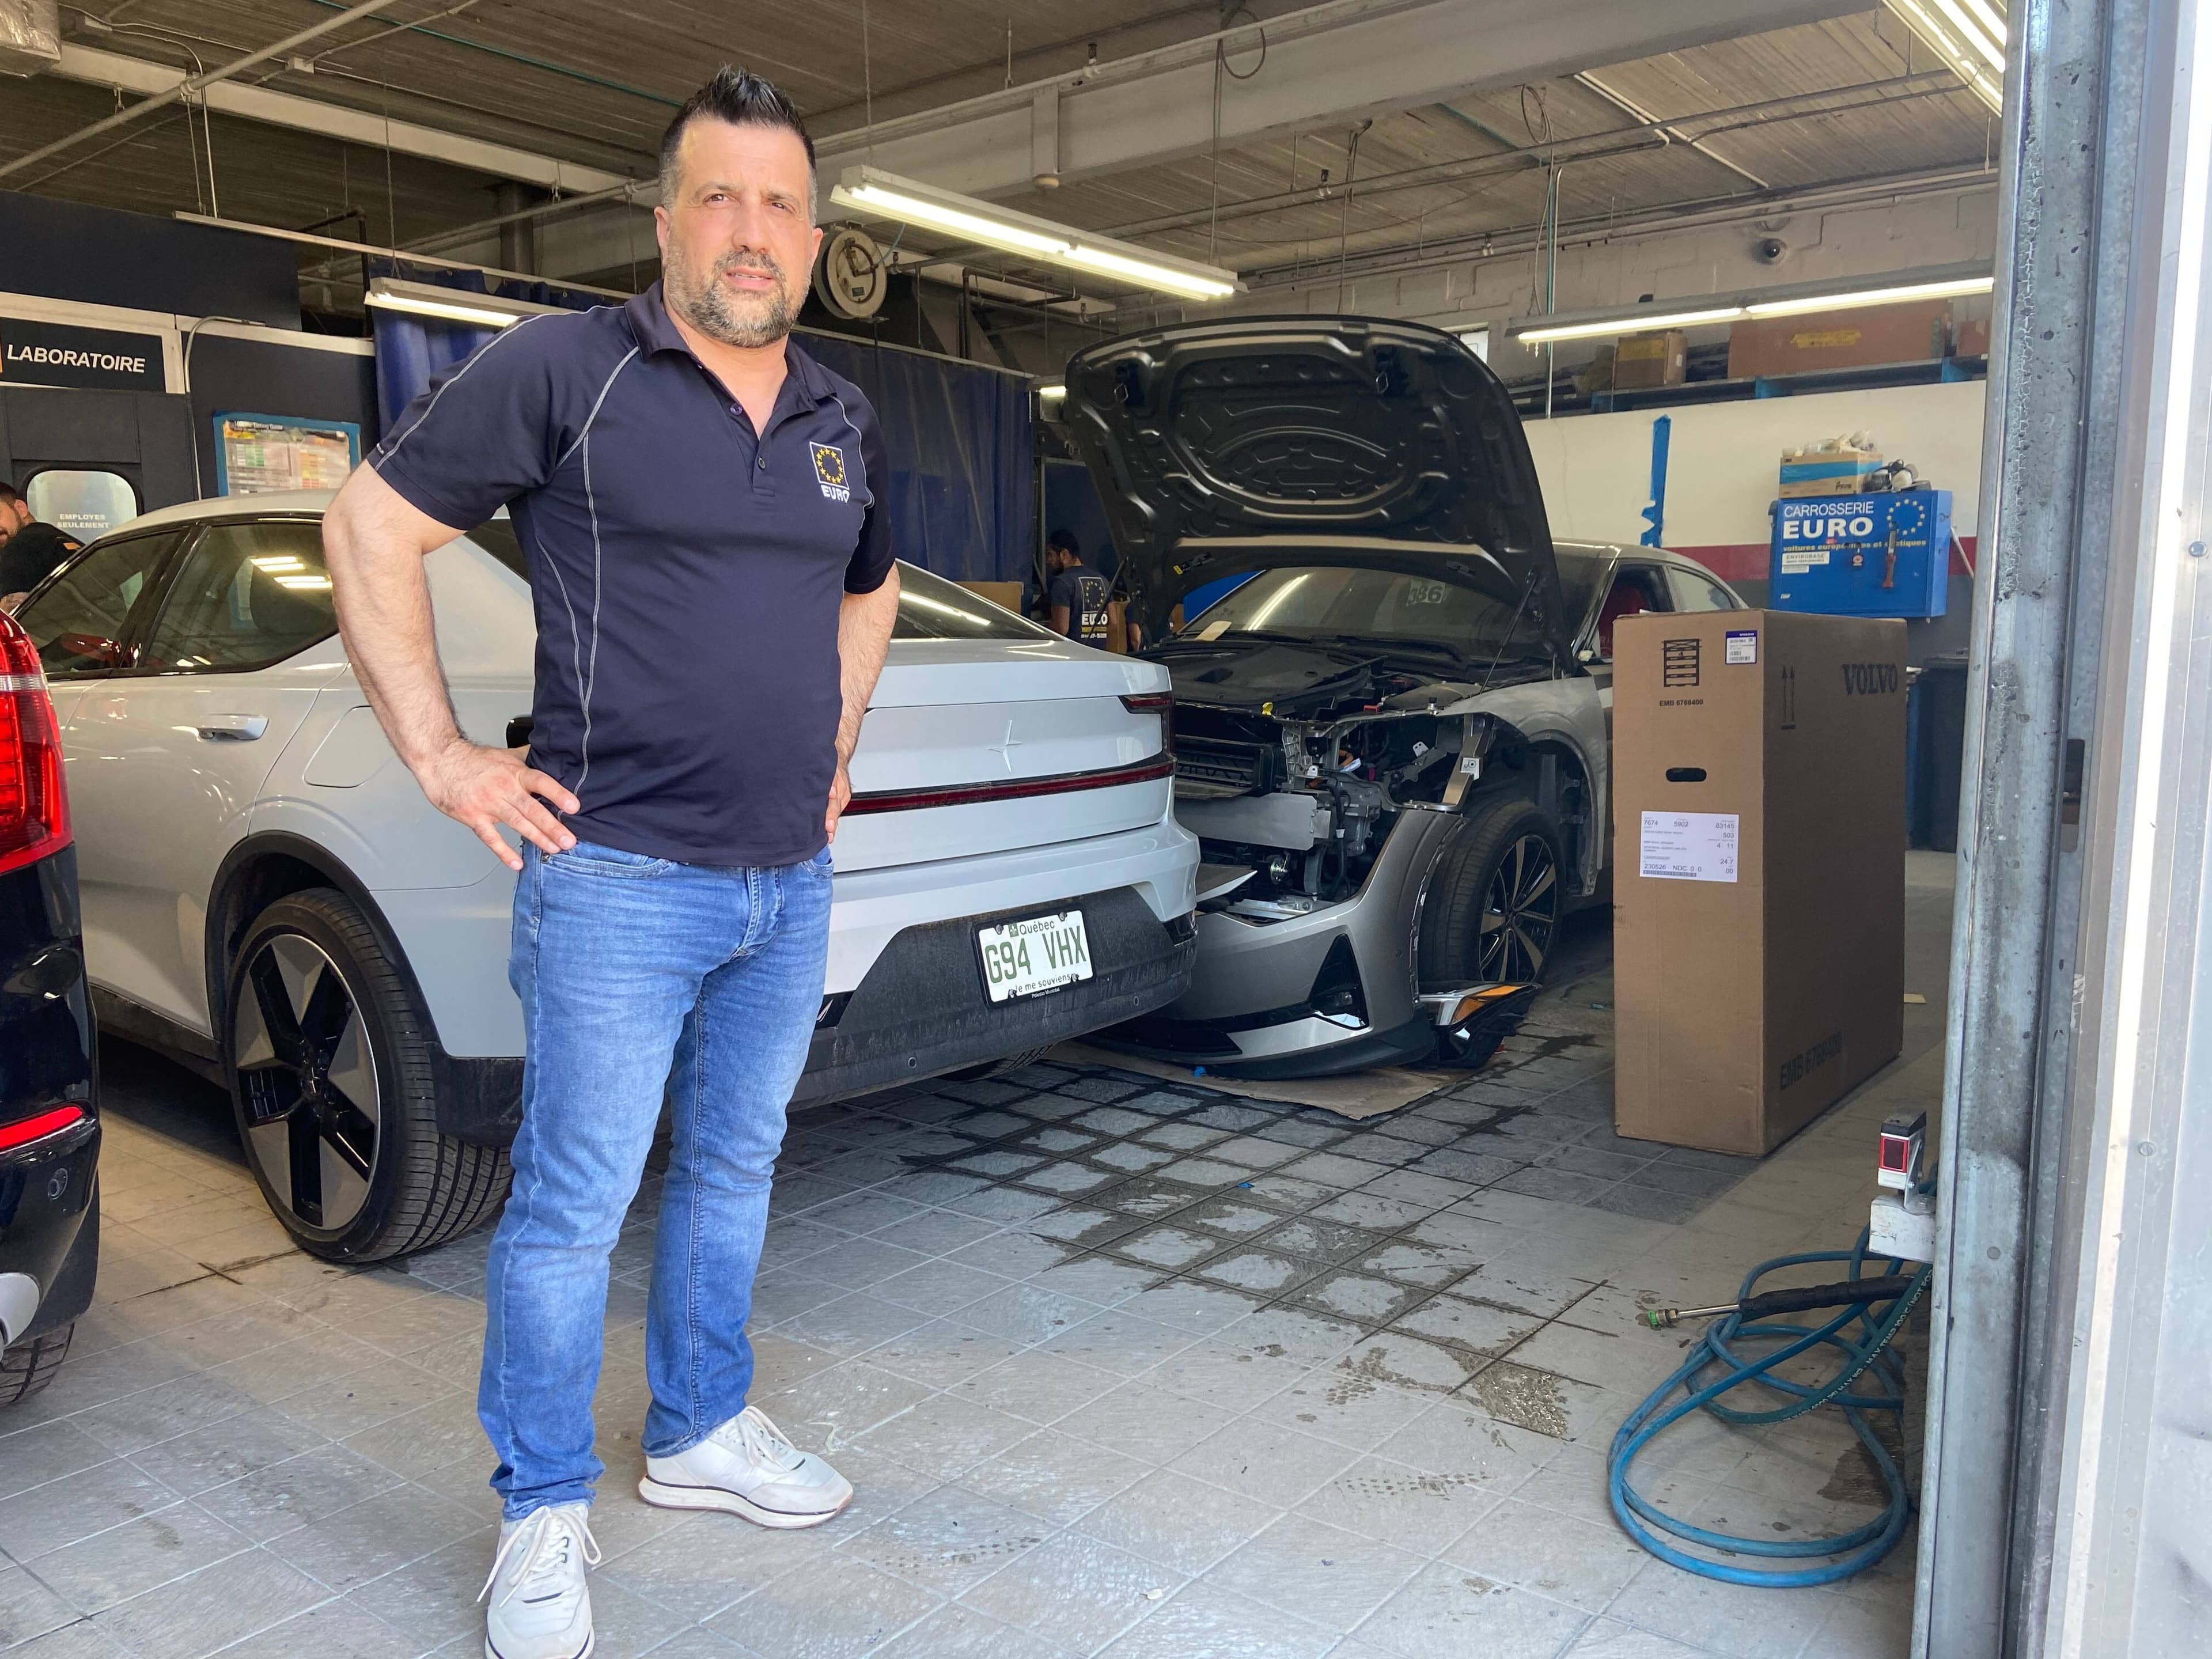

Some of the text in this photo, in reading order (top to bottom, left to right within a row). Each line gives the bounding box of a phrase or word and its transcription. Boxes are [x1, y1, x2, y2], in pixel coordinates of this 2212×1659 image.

[6, 343, 146, 373] LABORATOIRE
[820, 484, 850, 504] EURO
[1784, 501, 1874, 517] CARROSSERIE
[1783, 516, 1874, 540] EURO
[1081, 613, 1108, 626] EUO
[1842, 663, 1899, 695] VOLVO
[1019, 919, 1055, 935] Québec
[984, 925, 1087, 984] G94 VHX
[1025, 982, 1036, 991] me
[1038, 974, 1071, 986] souviens
